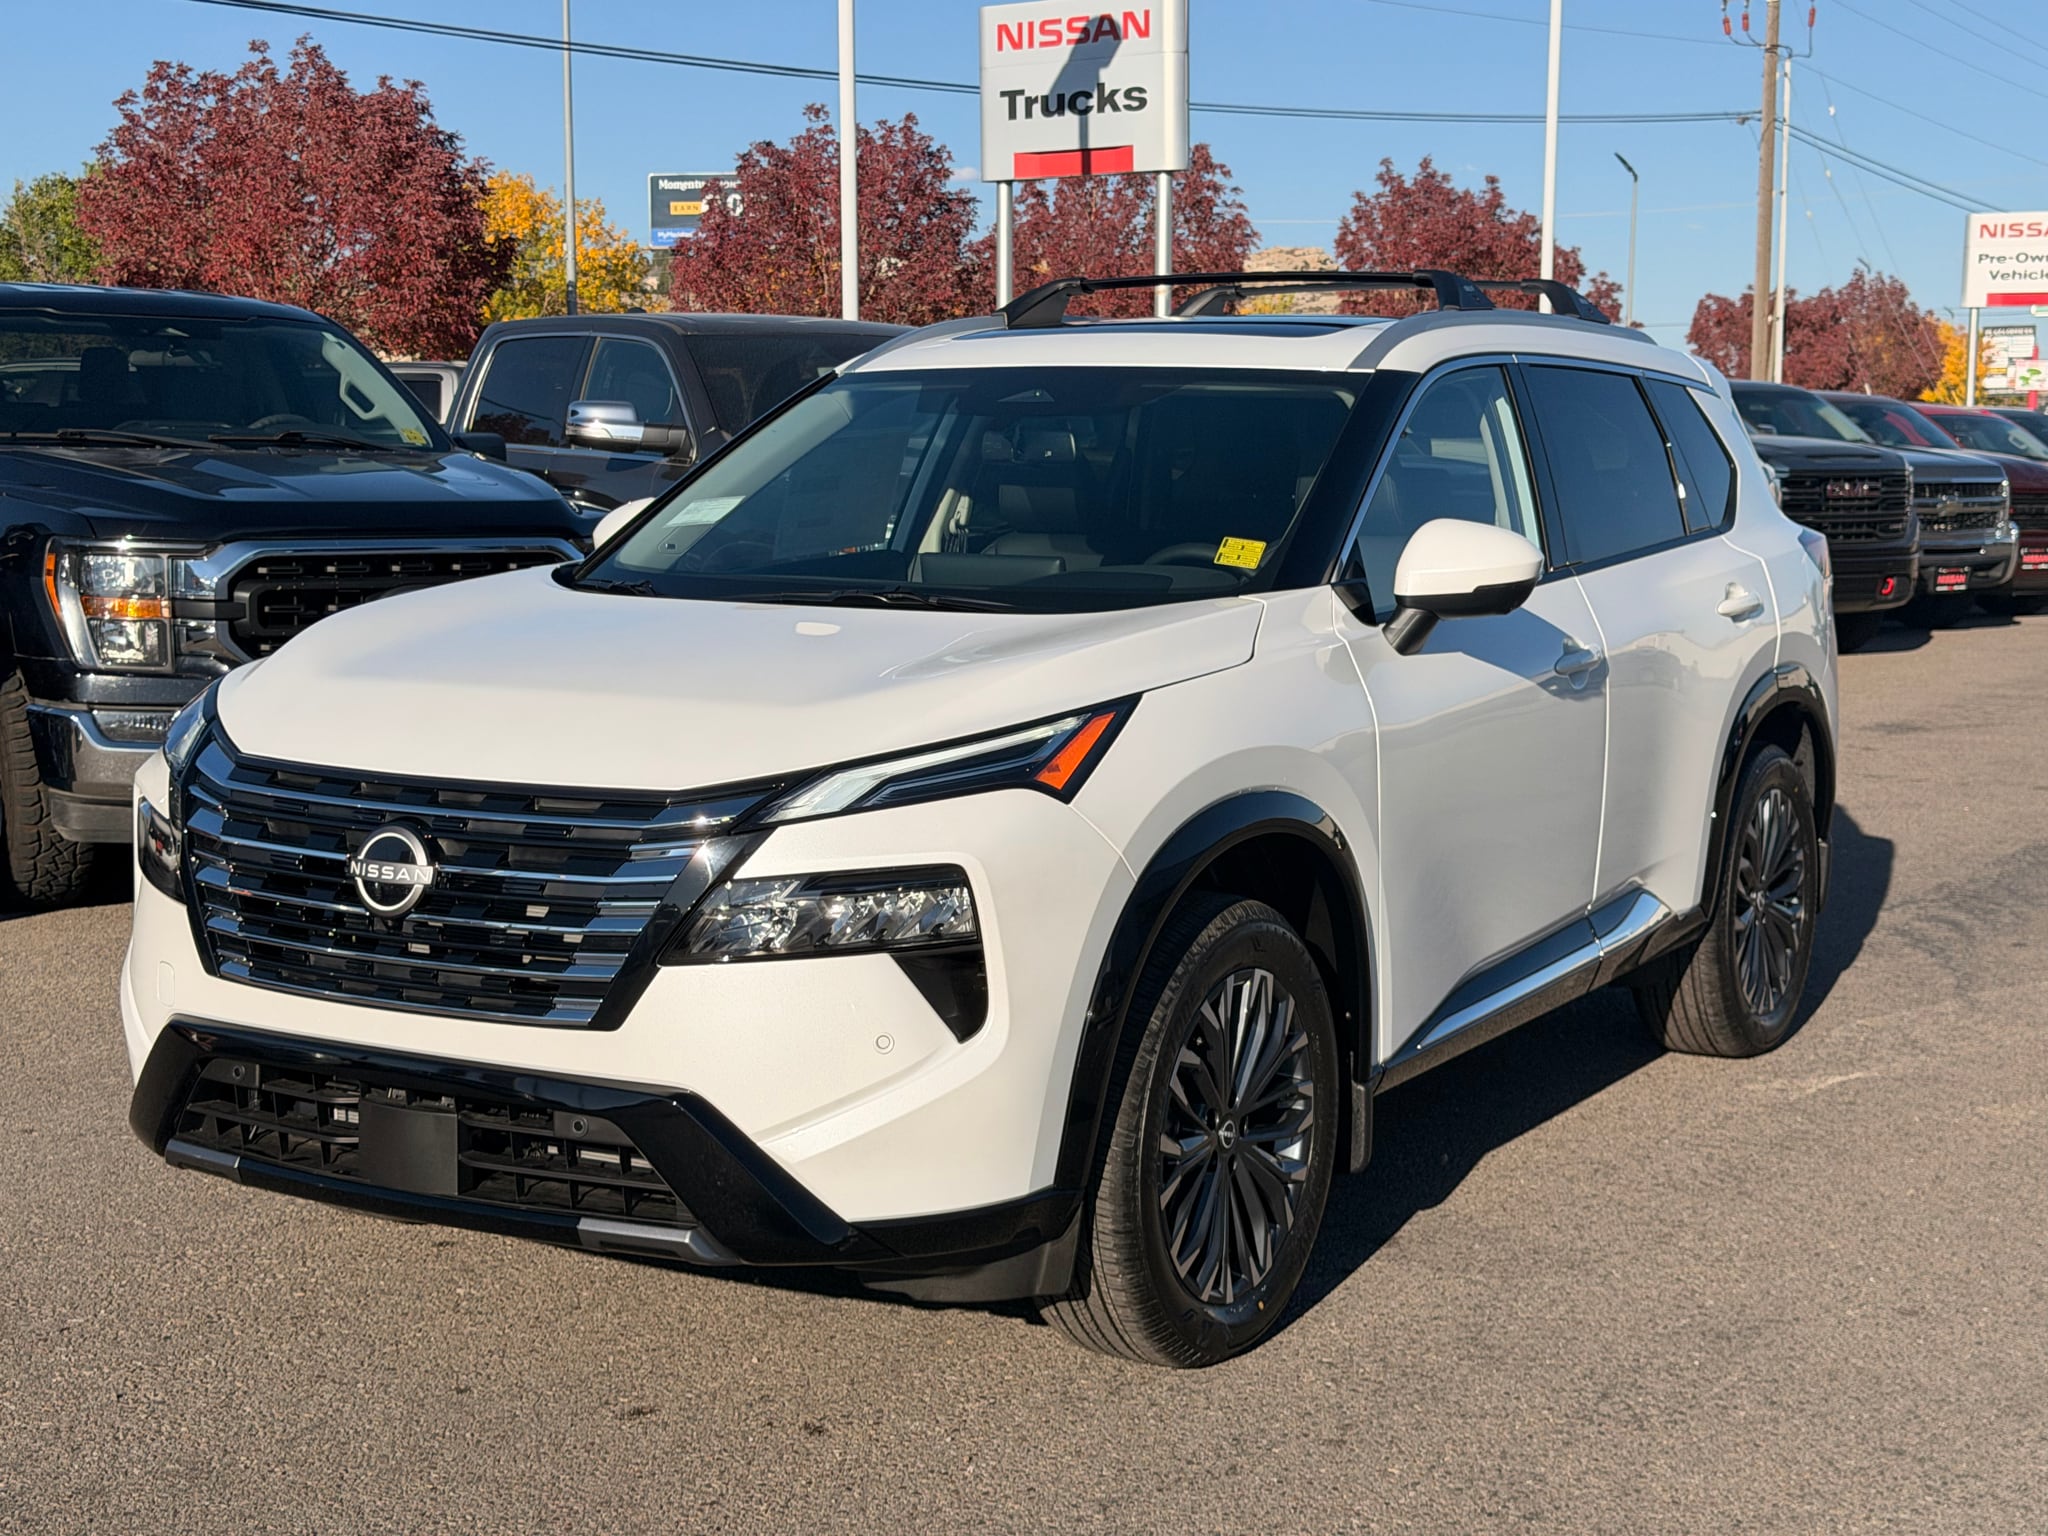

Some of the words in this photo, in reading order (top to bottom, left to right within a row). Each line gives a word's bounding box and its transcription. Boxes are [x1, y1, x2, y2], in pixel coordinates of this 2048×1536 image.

[997, 9, 1150, 52] NISSAN
[1000, 82, 1148, 121] Trucks
[1978, 252, 2048, 264] Pre-Ow
[350, 860, 431, 883] NISSAN
